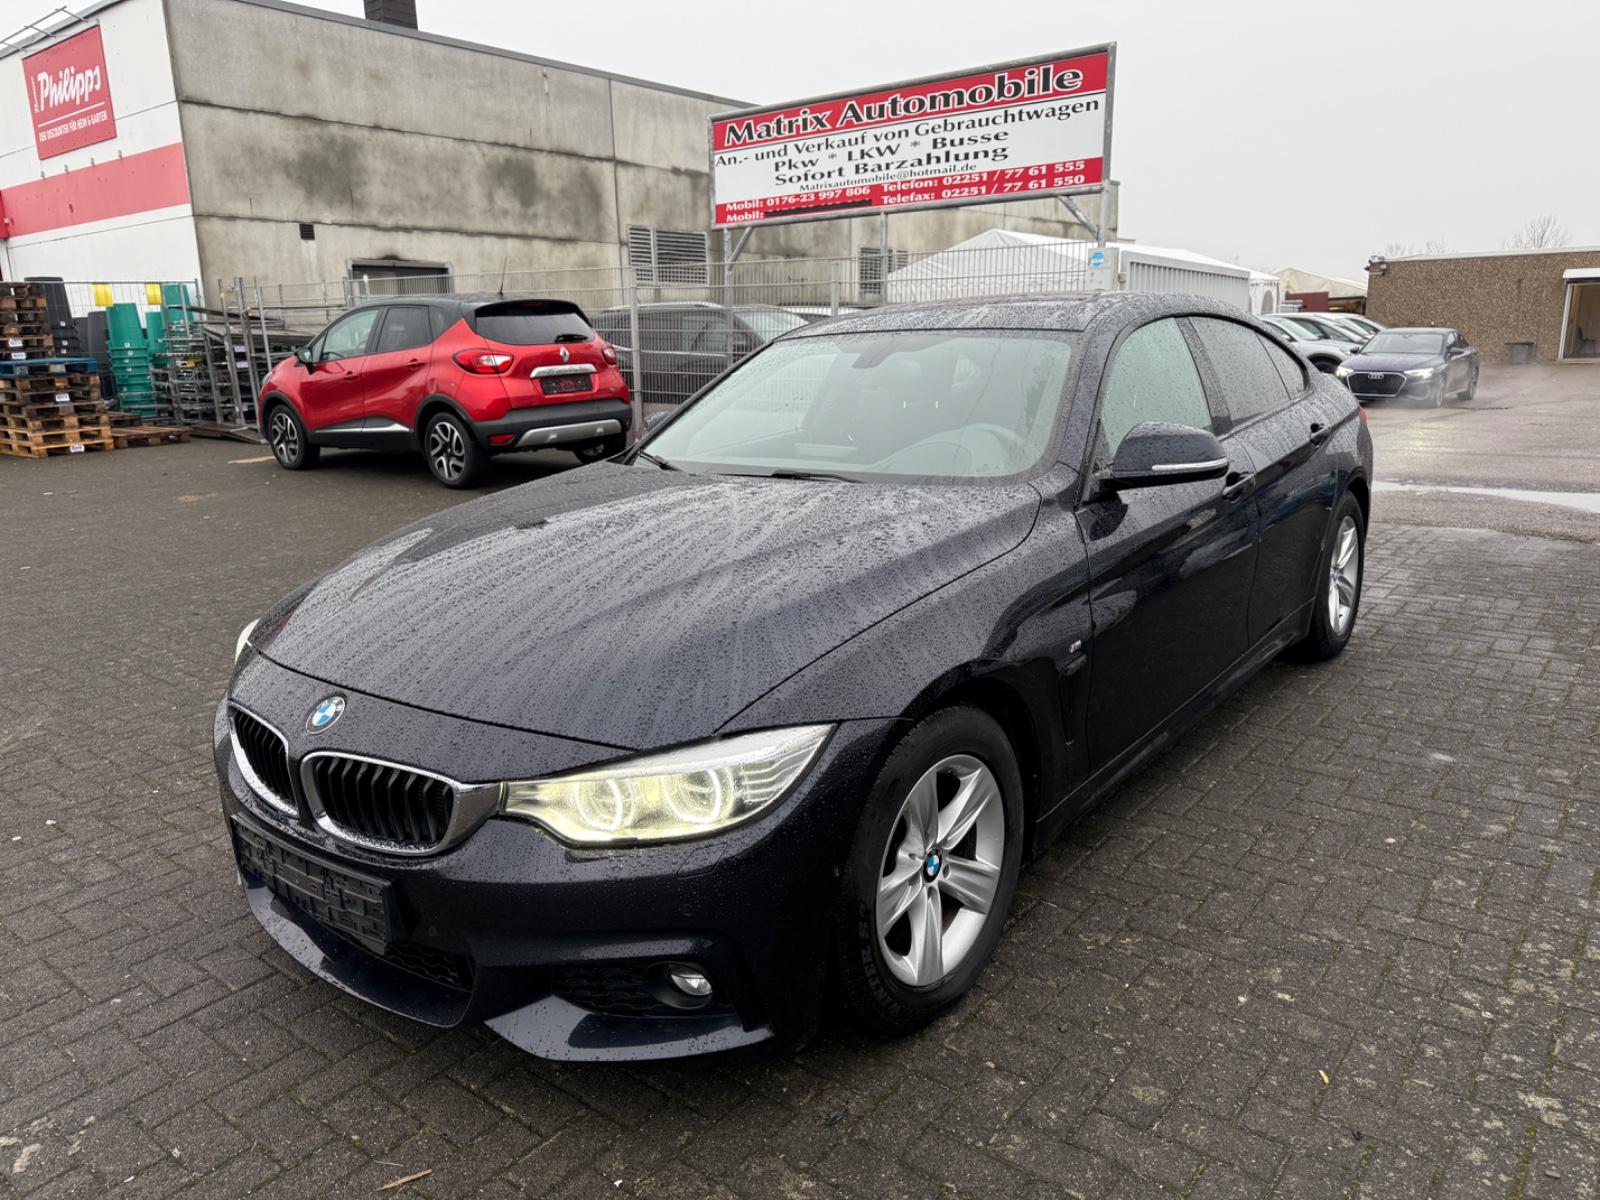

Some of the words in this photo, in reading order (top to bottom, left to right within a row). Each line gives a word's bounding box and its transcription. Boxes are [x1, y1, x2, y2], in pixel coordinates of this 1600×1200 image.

[37, 65, 101, 111] Philipps
[724, 108, 833, 147] Matrix
[836, 64, 1083, 127] Automobile
[716, 155, 749, 167] An.-
[755, 145, 788, 161] und
[794, 132, 867, 153] Verkauf
[872, 128, 909, 143] von
[915, 99, 1099, 137] Gebrauchtwagen
[774, 158, 819, 172] Pkw
[847, 143, 901, 162] LKW
[932, 130, 1009, 150] Busse
[775, 166, 846, 186] Sofort
[855, 146, 1009, 175] Barzahlung
[800, 163, 977, 191] Matrixautomobile@hotmail.de
[881, 178, 938, 193] Telefon:
[942, 172, 987, 186] 02251
[1005, 167, 1024, 179] 77
[1028, 165, 1047, 177] 61
[1053, 160, 1085, 173] 555
[726, 199, 764, 212] Mobil:
[766, 193, 815, 206] 0176-23
[818, 189, 843, 200] 997
[845, 186, 871, 197] 806
[881, 192, 935, 205] Telefax:
[941, 185, 987, 199] 02251
[1003, 181, 1023, 193] 77
[1028, 178, 1047, 190] 61
[1053, 174, 1085, 187] 550
[726, 211, 764, 222] Mobil:
